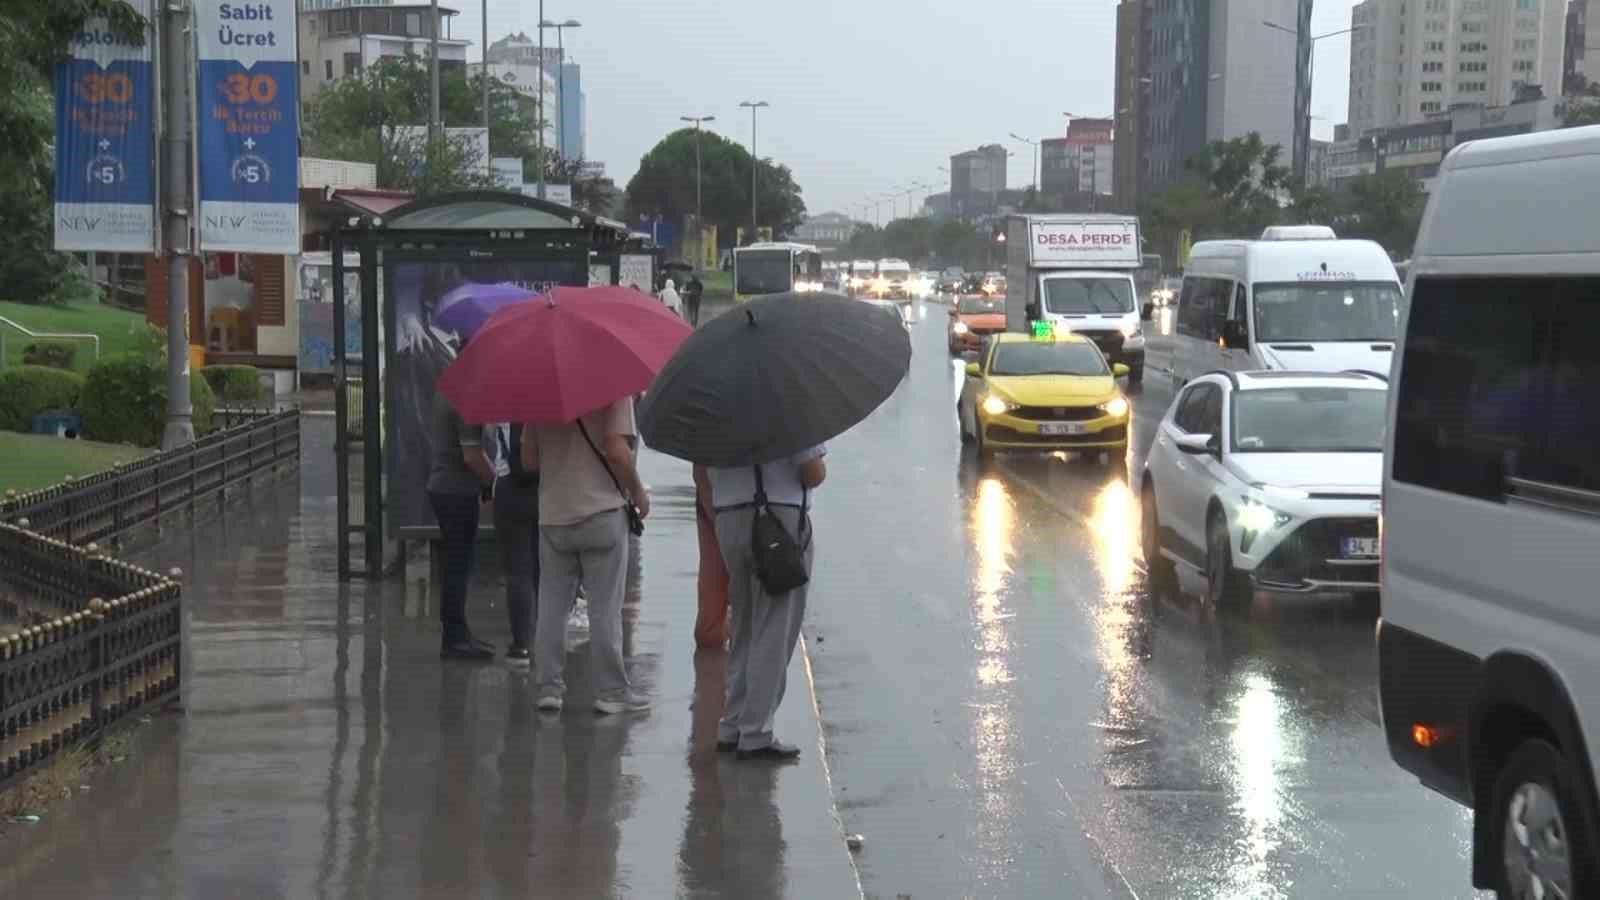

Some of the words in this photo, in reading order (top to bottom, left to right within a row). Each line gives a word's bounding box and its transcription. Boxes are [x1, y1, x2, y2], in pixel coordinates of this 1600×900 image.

[219, 3, 273, 20] Sabit
[218, 25, 277, 46] Ücret
[60, 216, 102, 231] NEW
[206, 215, 248, 229] NEW
[1038, 233, 1079, 245] DESA
[1081, 233, 1132, 245] PERDE
